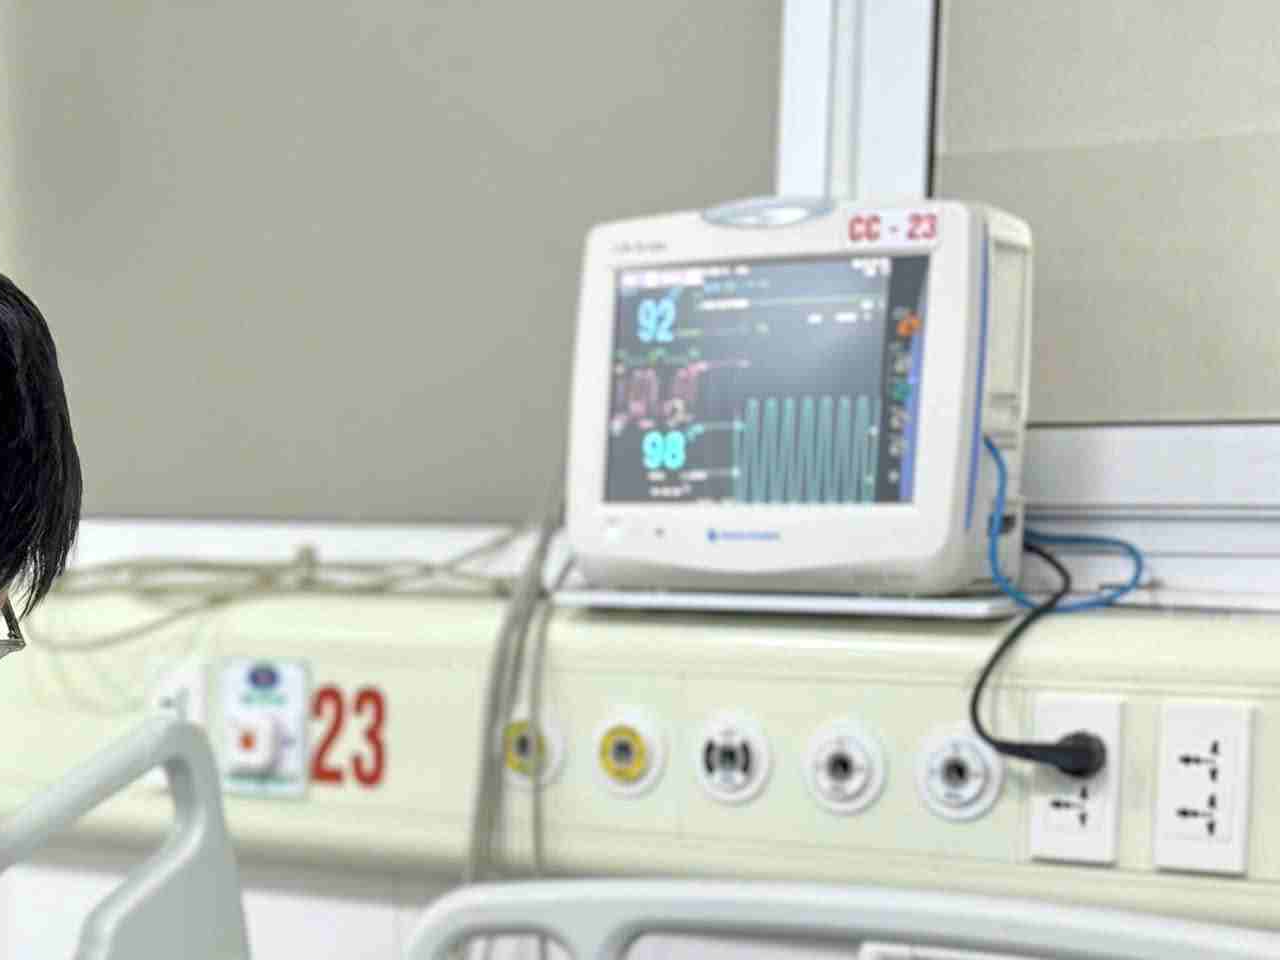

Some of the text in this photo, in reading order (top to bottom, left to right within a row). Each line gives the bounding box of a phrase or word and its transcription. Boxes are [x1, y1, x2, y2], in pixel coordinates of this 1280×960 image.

[847, 214, 881, 241] CC
[906, 213, 938, 240] 23
[638, 298, 675, 342] 92
[310, 683, 385, 788] 23
